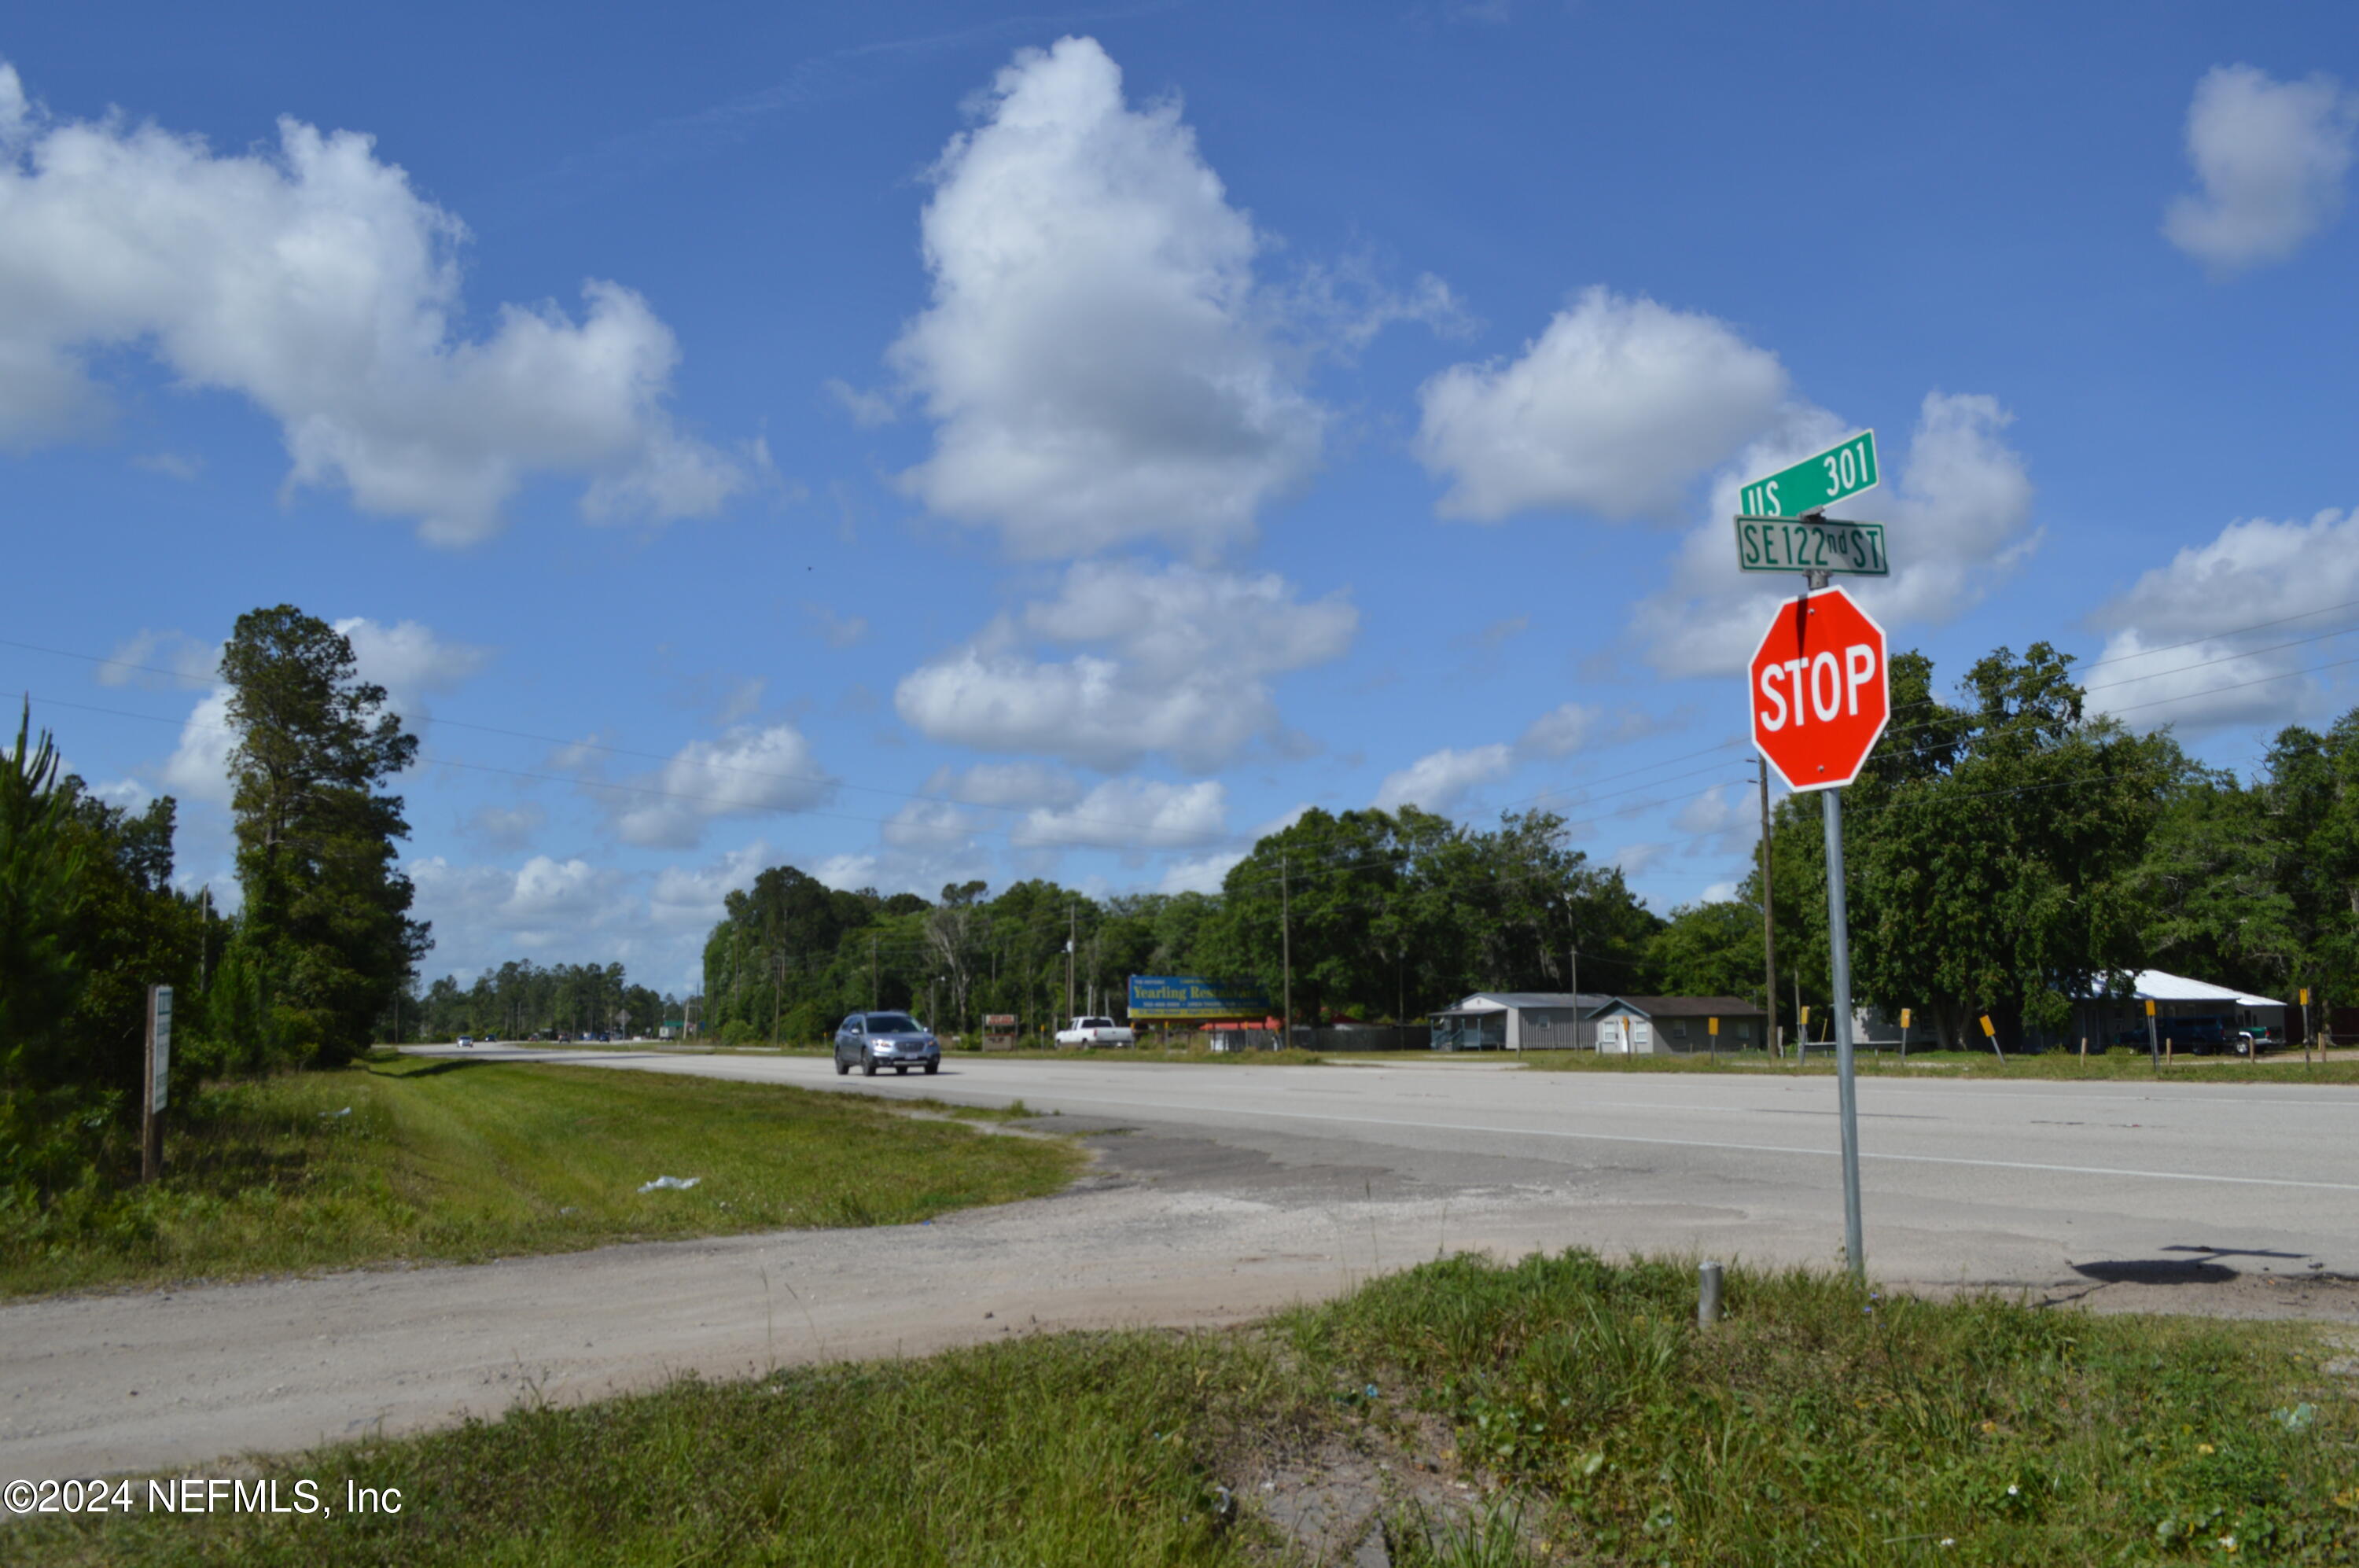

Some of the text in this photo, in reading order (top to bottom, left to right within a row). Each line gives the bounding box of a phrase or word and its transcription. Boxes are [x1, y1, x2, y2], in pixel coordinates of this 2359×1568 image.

[1748, 442, 1868, 517] US 301
[1744, 525, 1878, 569] SE 122nd ST
[1761, 643, 1875, 732] STOP
[1133, 985, 1187, 1001] Yearling
